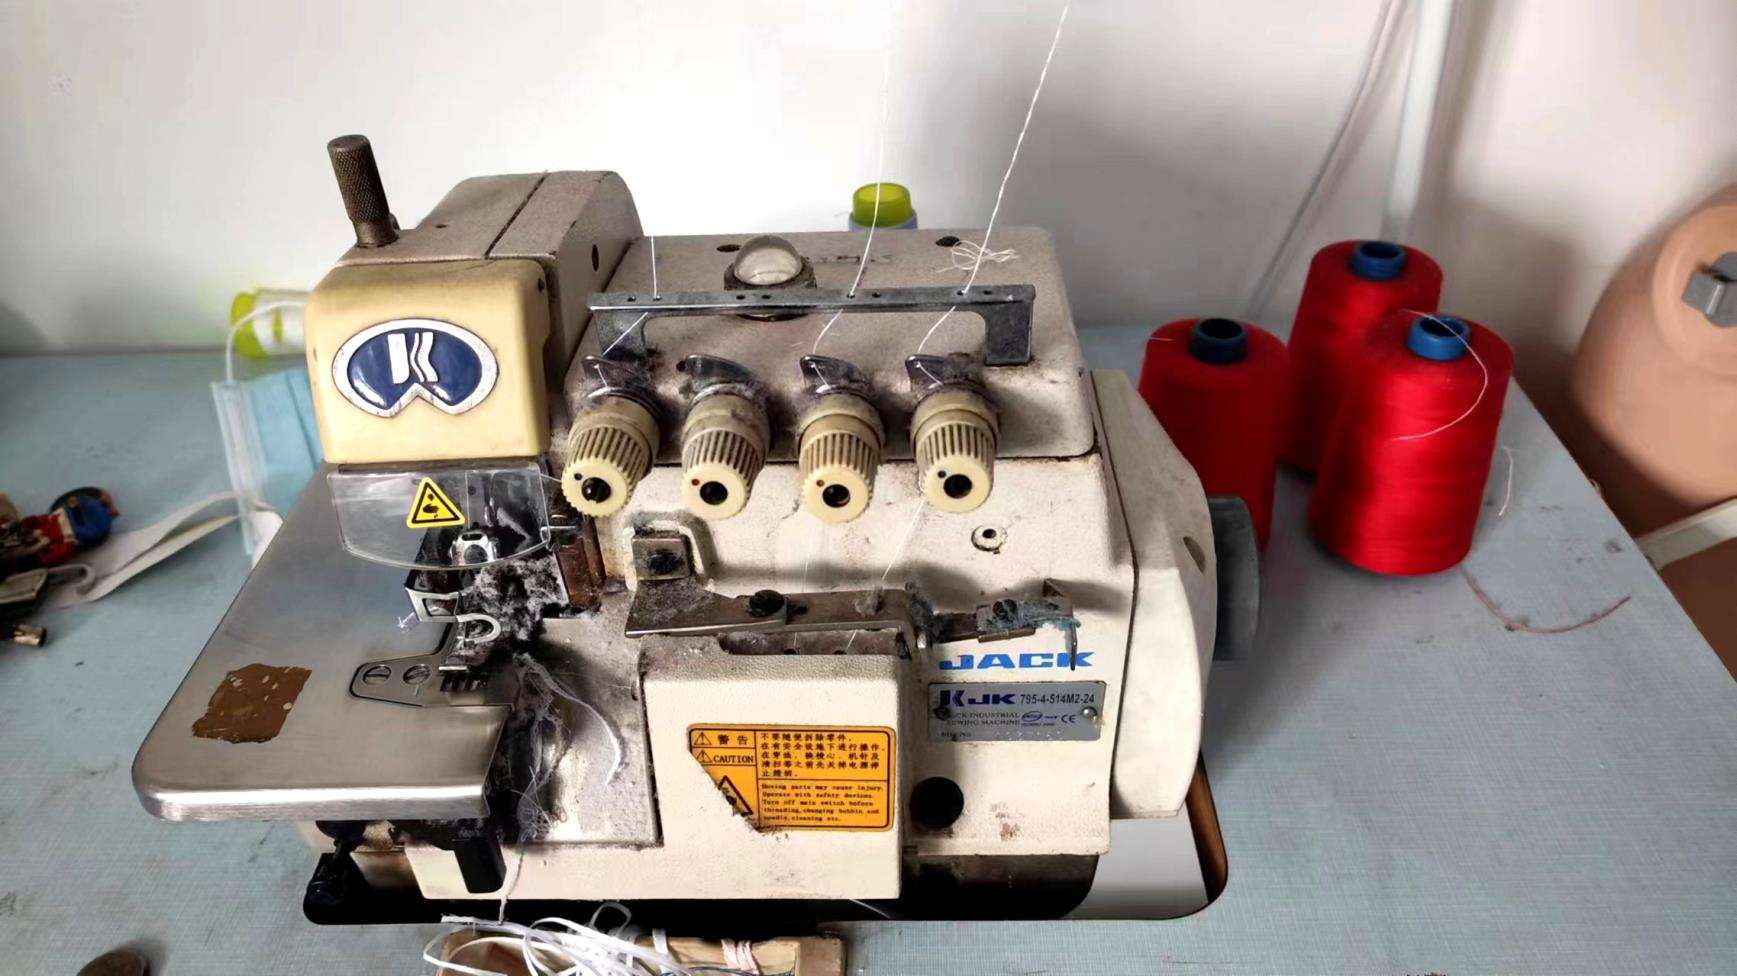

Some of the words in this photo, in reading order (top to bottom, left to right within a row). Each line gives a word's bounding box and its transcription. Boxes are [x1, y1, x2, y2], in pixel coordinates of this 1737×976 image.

[939, 652, 1094, 670] JACK
[1020, 693, 1095, 704] 795-4-514M2-24
[713, 755, 754, 763] CAUTION
